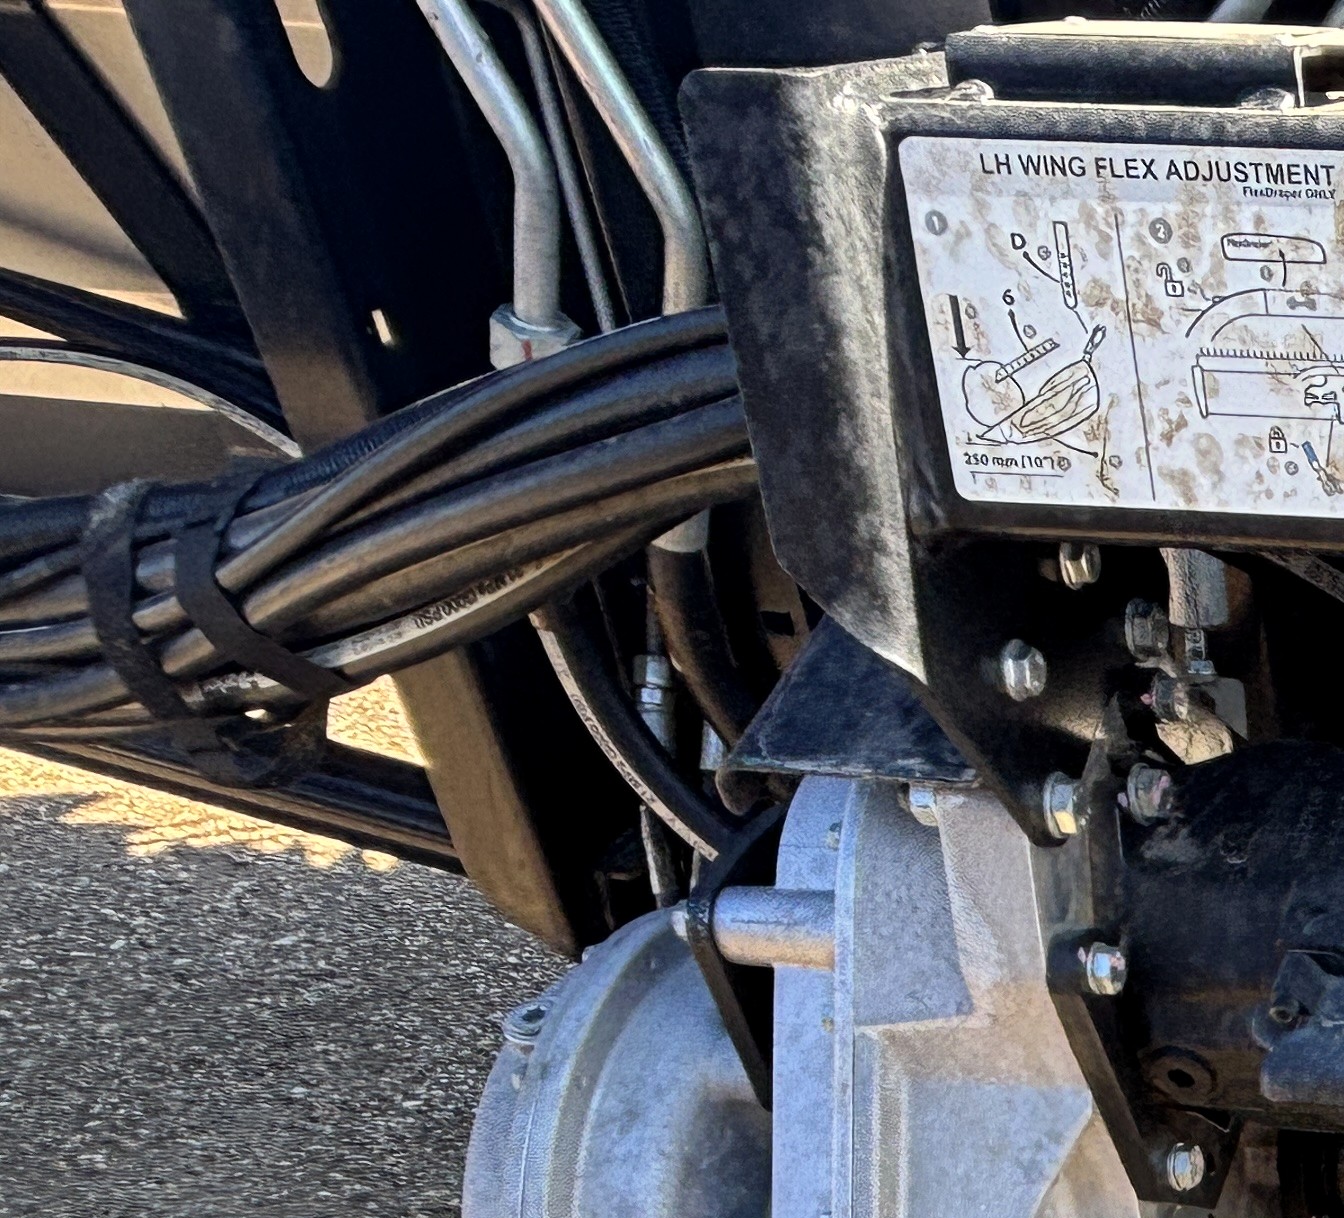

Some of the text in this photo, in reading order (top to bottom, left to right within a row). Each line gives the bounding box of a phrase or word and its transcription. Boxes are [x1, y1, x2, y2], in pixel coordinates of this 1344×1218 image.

[980, 153, 1335, 186] LH WING FLEX ADJUSTMENT
[1002, 289, 1015, 305] 6
[992, 455, 1019, 468] mm
